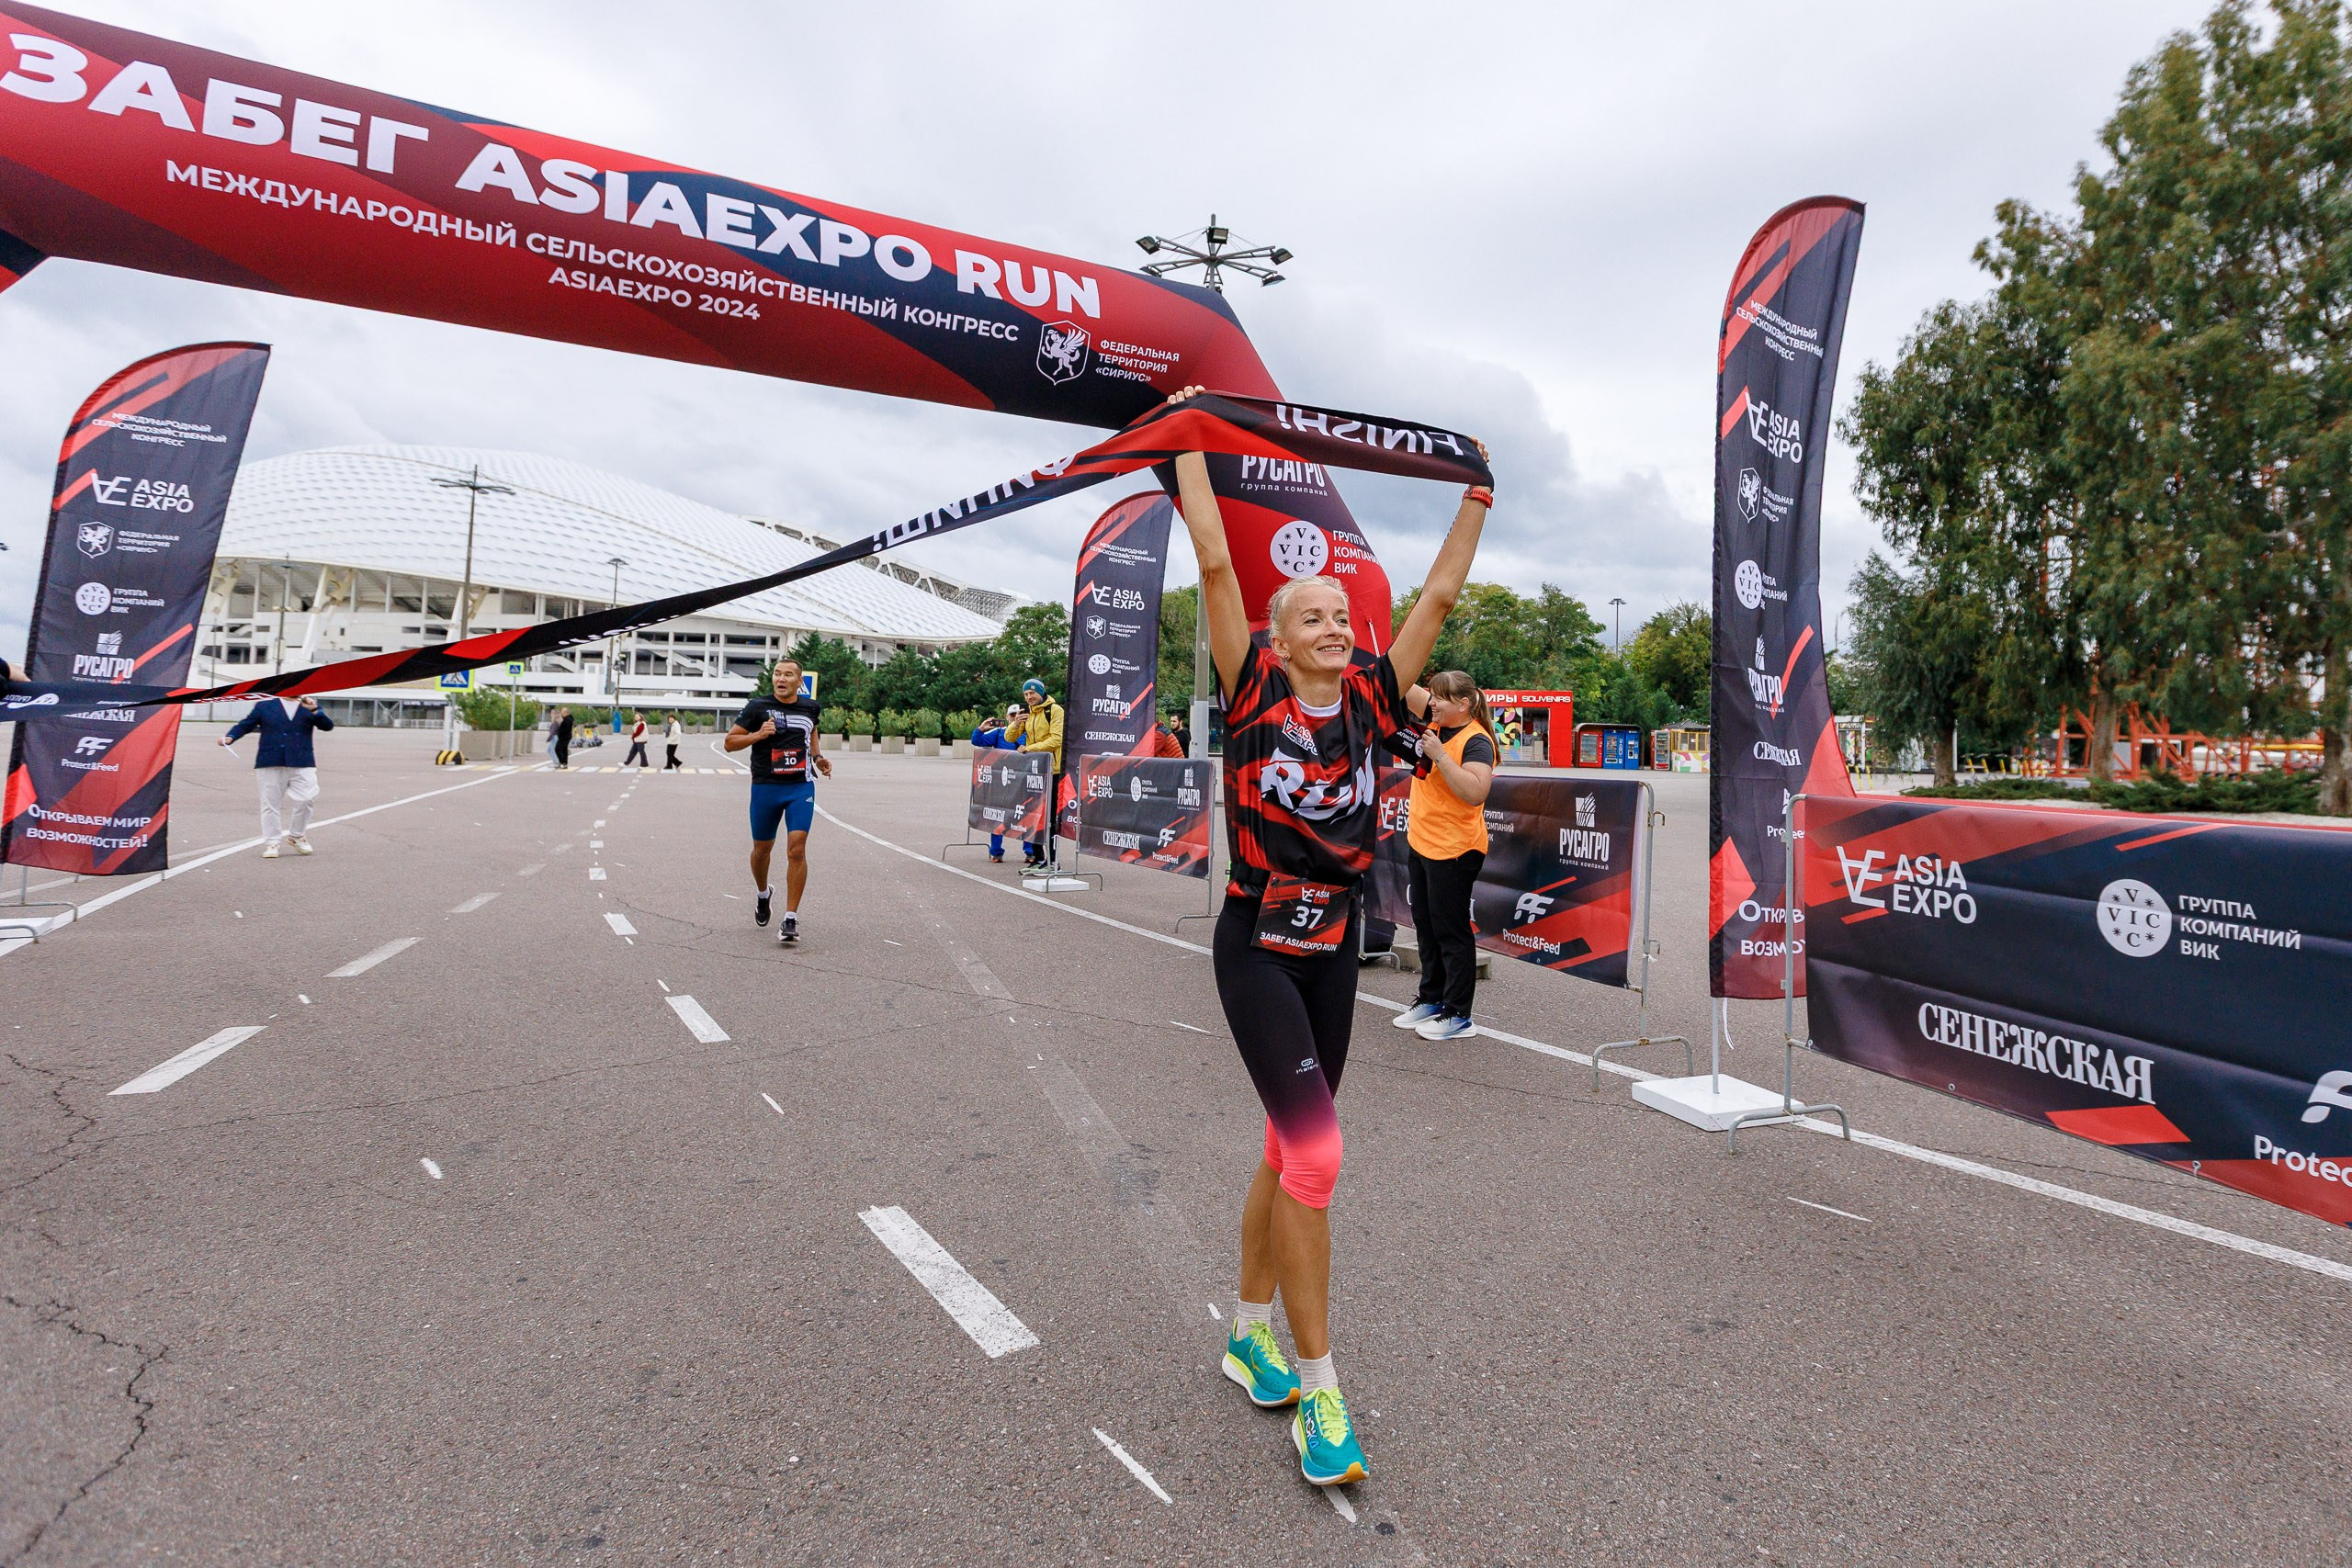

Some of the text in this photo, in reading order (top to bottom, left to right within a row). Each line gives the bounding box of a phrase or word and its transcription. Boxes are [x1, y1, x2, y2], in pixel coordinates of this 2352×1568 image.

[0, 33, 1101, 319] ЗАБЕГ ASIAEXPO RUN
[165, 160, 1020, 341] МЕЖДУНАРОДНЫЙ СЕЛЬСКОХОЗЯЙСТВЕННЫЙ КОНГРЕСС
[548, 267, 760, 320] ASIAEXPO 2024
[1750, 299, 1817, 340] МЕЖДУНАРОДНЫЙ
[1101, 340, 1180, 362] ФЕДЕРАЛЬНАЯ
[1765, 336, 1795, 361] КОНГРЕСС
[1099, 354, 1168, 373] ТЕРРИТОРИЯ
[1095, 367, 1152, 382] «СИРИУС»
[1769, 410, 1800, 441] ASIA
[1768, 430, 1803, 463] EXPO
[133, 479, 190, 498] ASIA
[1240, 483, 1329, 497] группа компаний
[130, 493, 195, 513] EXPO
[1333, 530, 1366, 547] ГРУППА
[1109, 557, 1136, 566] КОНГРЕСС
[1334, 562, 1358, 574] ВИК
[1113, 599, 1145, 611] EXPO
[1114, 589, 1142, 601] ASIA
[73, 654, 135, 679] РУСАГРО
[1092, 698, 1131, 716] РУСАГРО
[1521, 695, 1571, 704] SOUVENIRS
[1085, 731, 1135, 743] СЕНЕЖСКАЯ
[62, 758, 119, 773] Protect&Feed
[785, 757, 797, 765] 10
[1098, 776, 1111, 787] ASIA
[1260, 747, 1375, 825] RUN
[1098, 786, 1114, 799] EXPO
[1178, 788, 1200, 807] РУСАГРО
[1484, 810, 1504, 820] ГРУППА
[1559, 828, 1610, 863] РУСАГРО
[1559, 858, 1578, 867] группа
[1894, 854, 1968, 890] ASIA
[1315, 890, 1330, 898] ASIA
[1893, 883, 1977, 924] EXPO
[2178, 895, 2256, 919] ГРУППА
[1291, 906, 1324, 930] 37
[1260, 931, 1338, 952] ЗАБЕГ ASIAEXPO RUN
[1502, 928, 1562, 956] Protect&Feed
[2180, 917, 2301, 950] КОМПАНИЙ
[2180, 939, 2220, 960] ВИК
[1918, 1002, 2154, 1105] СЕНЕЖСКАЯ
[1303, 1408, 1321, 1450] HOKA
